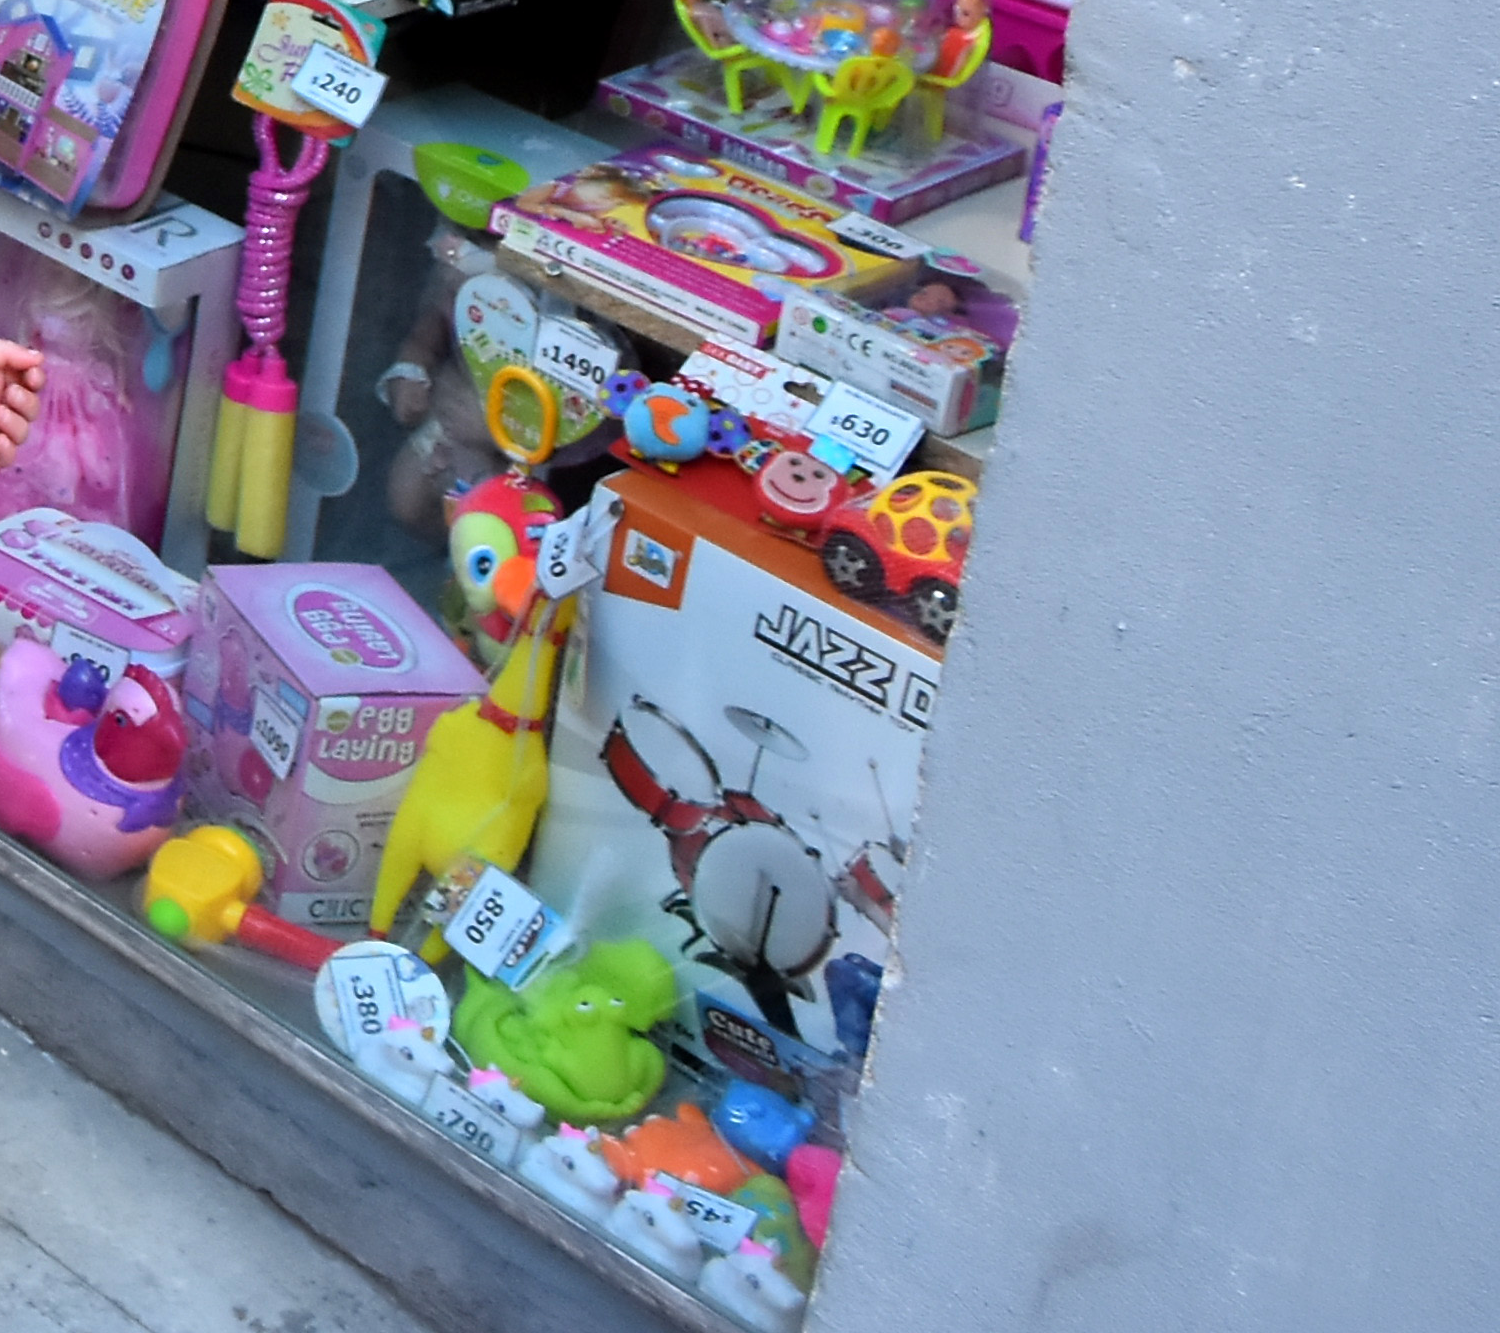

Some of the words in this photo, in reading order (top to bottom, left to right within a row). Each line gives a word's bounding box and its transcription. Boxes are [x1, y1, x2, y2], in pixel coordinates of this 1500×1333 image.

[311, 71, 363, 106] $240
[541, 343, 607, 386] $1490
[831, 411, 890, 447] $630
[755, 604, 897, 708] JAZZ
[358, 705, 415, 735] egg
[320, 733, 415, 765] Laying
[464, 888, 506, 946] $850
[350, 974, 383, 1036] $380
[706, 1009, 776, 1050] Cute
[435, 1108, 495, 1155] $790
